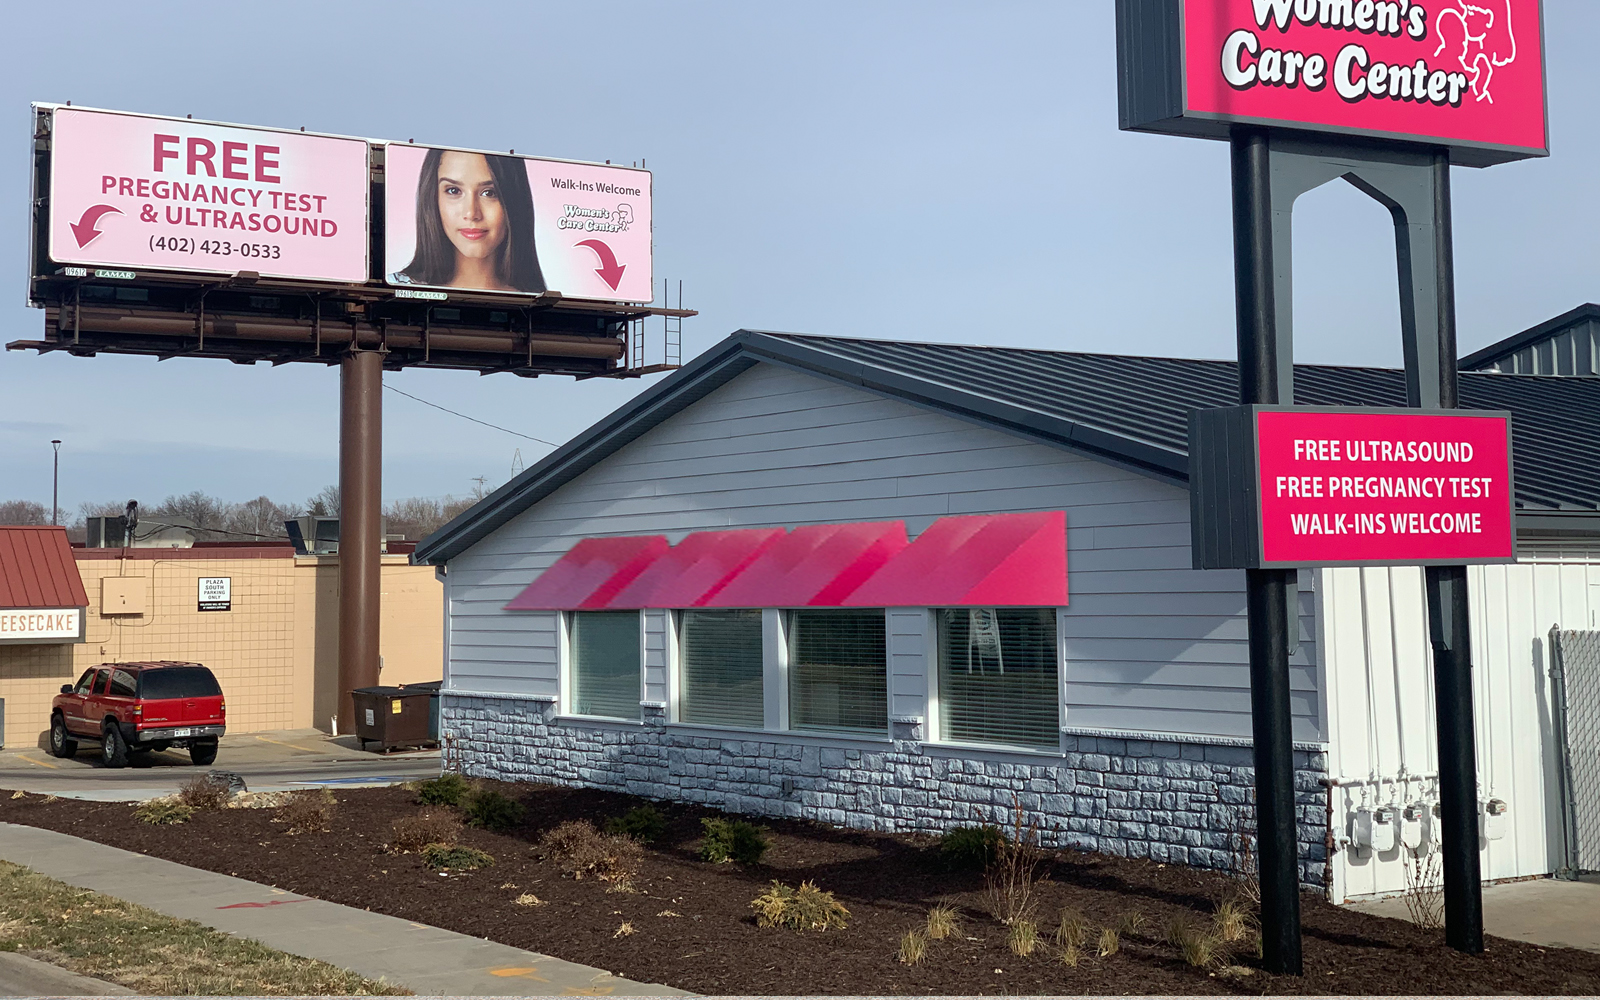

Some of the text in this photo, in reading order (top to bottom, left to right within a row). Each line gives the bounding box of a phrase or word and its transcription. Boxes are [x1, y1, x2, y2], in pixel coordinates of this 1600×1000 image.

[1221, 29, 1469, 106] Care Center
[152, 133, 281, 184] FREE
[101, 175, 327, 213] PREGNANCY TEST
[551, 177, 641, 197] Walk-Ins Welcome
[139, 203, 338, 238] & ULTRASOUND
[563, 204, 610, 219] Women's
[557, 216, 621, 233] Care Center
[149, 234, 281, 260] (402) 423-0533
[66, 267, 86, 276] 09612
[99, 270, 132, 279] LAMAR
[1294, 439, 1474, 463] FREE ULTRASOUND
[1276, 476, 1492, 498] FREE PREGNANCY TEST
[1290, 512, 1482, 535] WALK-INS WELCOME
[1, 614, 73, 631] EESECAKE
